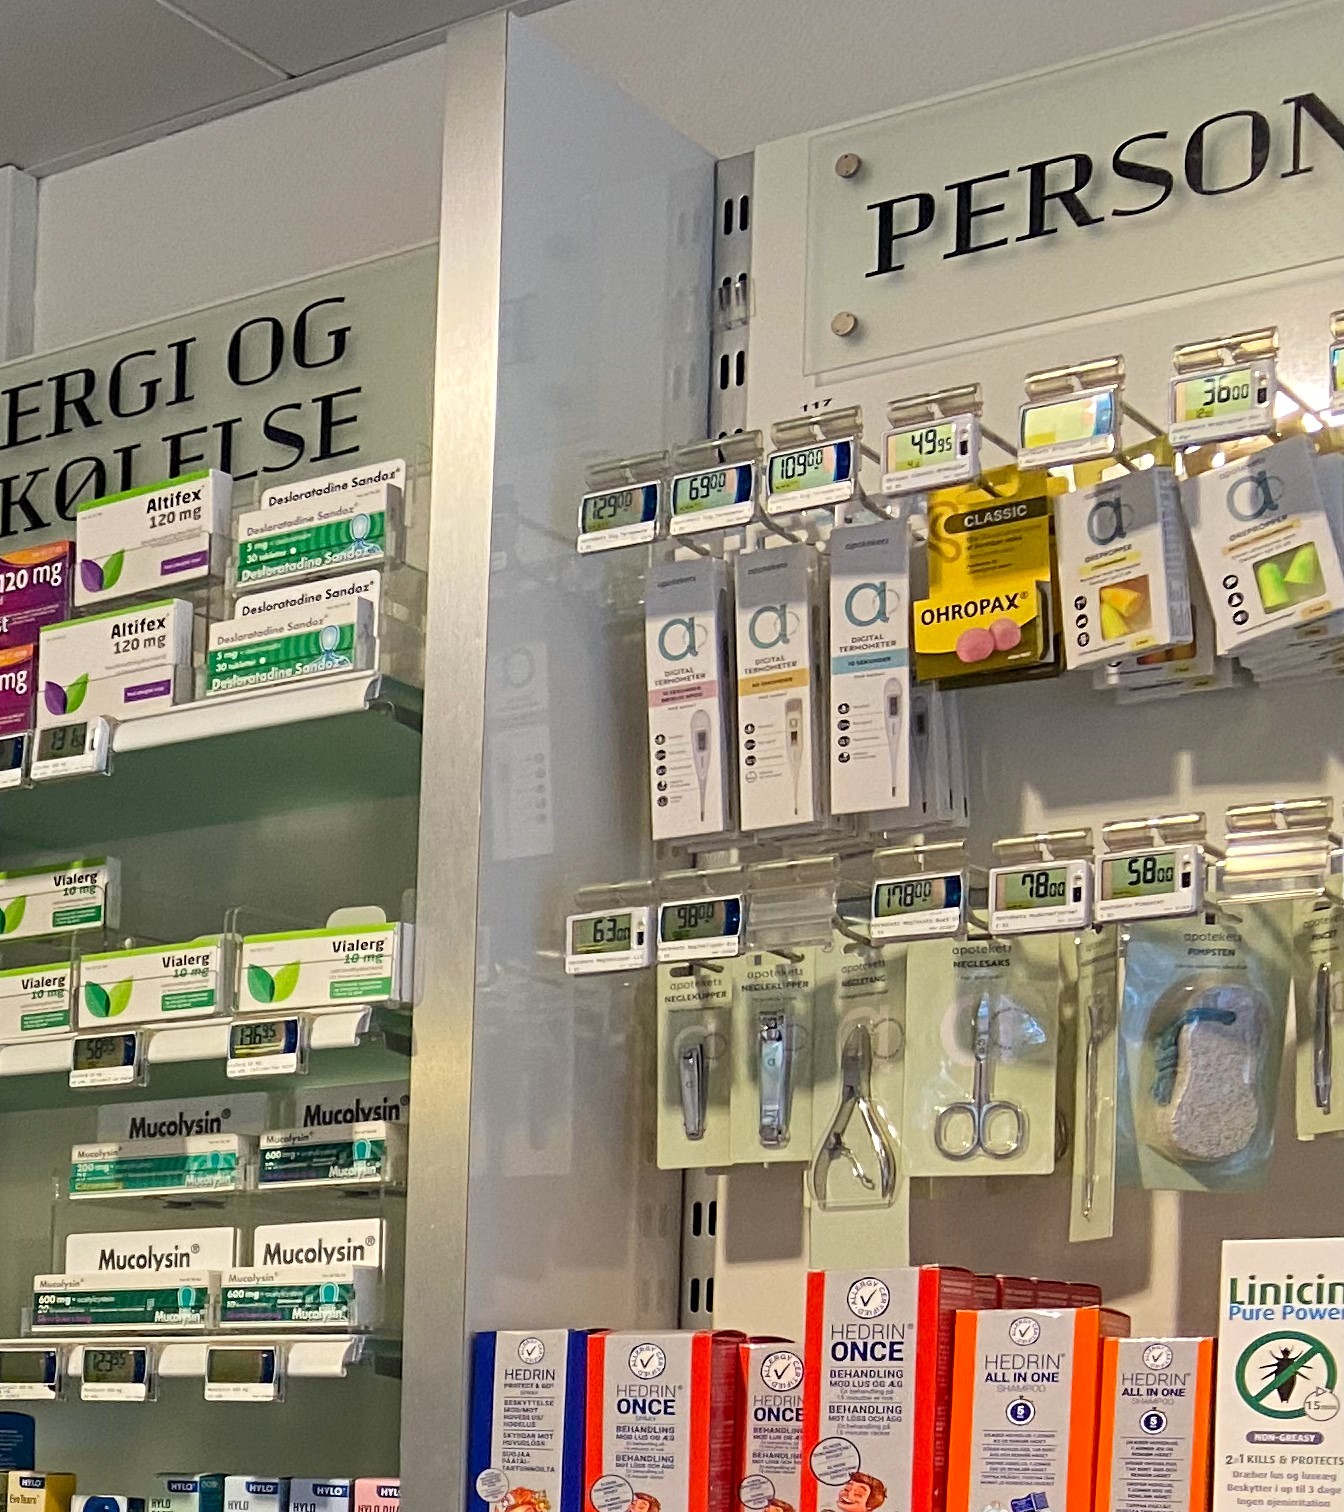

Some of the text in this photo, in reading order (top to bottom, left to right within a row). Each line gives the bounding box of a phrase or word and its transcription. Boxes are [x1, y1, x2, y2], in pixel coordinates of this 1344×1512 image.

[226, 296, 352, 386] OG
[146, 488, 202, 514] Altifex
[268, 482, 349, 507] Desloratadine
[149, 506, 202, 529] 120 mg
[963, 504, 1027, 529] CLASSIC
[32, 562, 63, 587] mg
[111, 616, 167, 640] Altifex
[333, 939, 385, 953] Vialerg
[162, 954, 210, 968] Vialerg
[21, 976, 66, 990] Vialerg
[1229, 1305, 1275, 1320] Pure
[831, 1341, 904, 1361] ONCE
[984, 1354, 1061, 1370] HEDRIN
[504, 1369, 555, 1381] HEDRIN
[830, 1370, 903, 1378] BEHANDLING
[985, 1372, 1059, 1383] ALL IN ONE
[1122, 1373, 1187, 1386] HEDRIN
[1122, 1388, 1186, 1397] ALL IN ONE
[617, 1399, 676, 1415] ONCE
[829, 1405, 902, 1414] BEHANDLING
[616, 1426, 674, 1434] BEHANDLING
[1254, 1433, 1316, 1442] NON-GREASY
[1247, 1455, 1275, 1464] KILLS
[1280, 1455, 1287, 1464] &
[293, 1503, 316, 1512] HYLO
